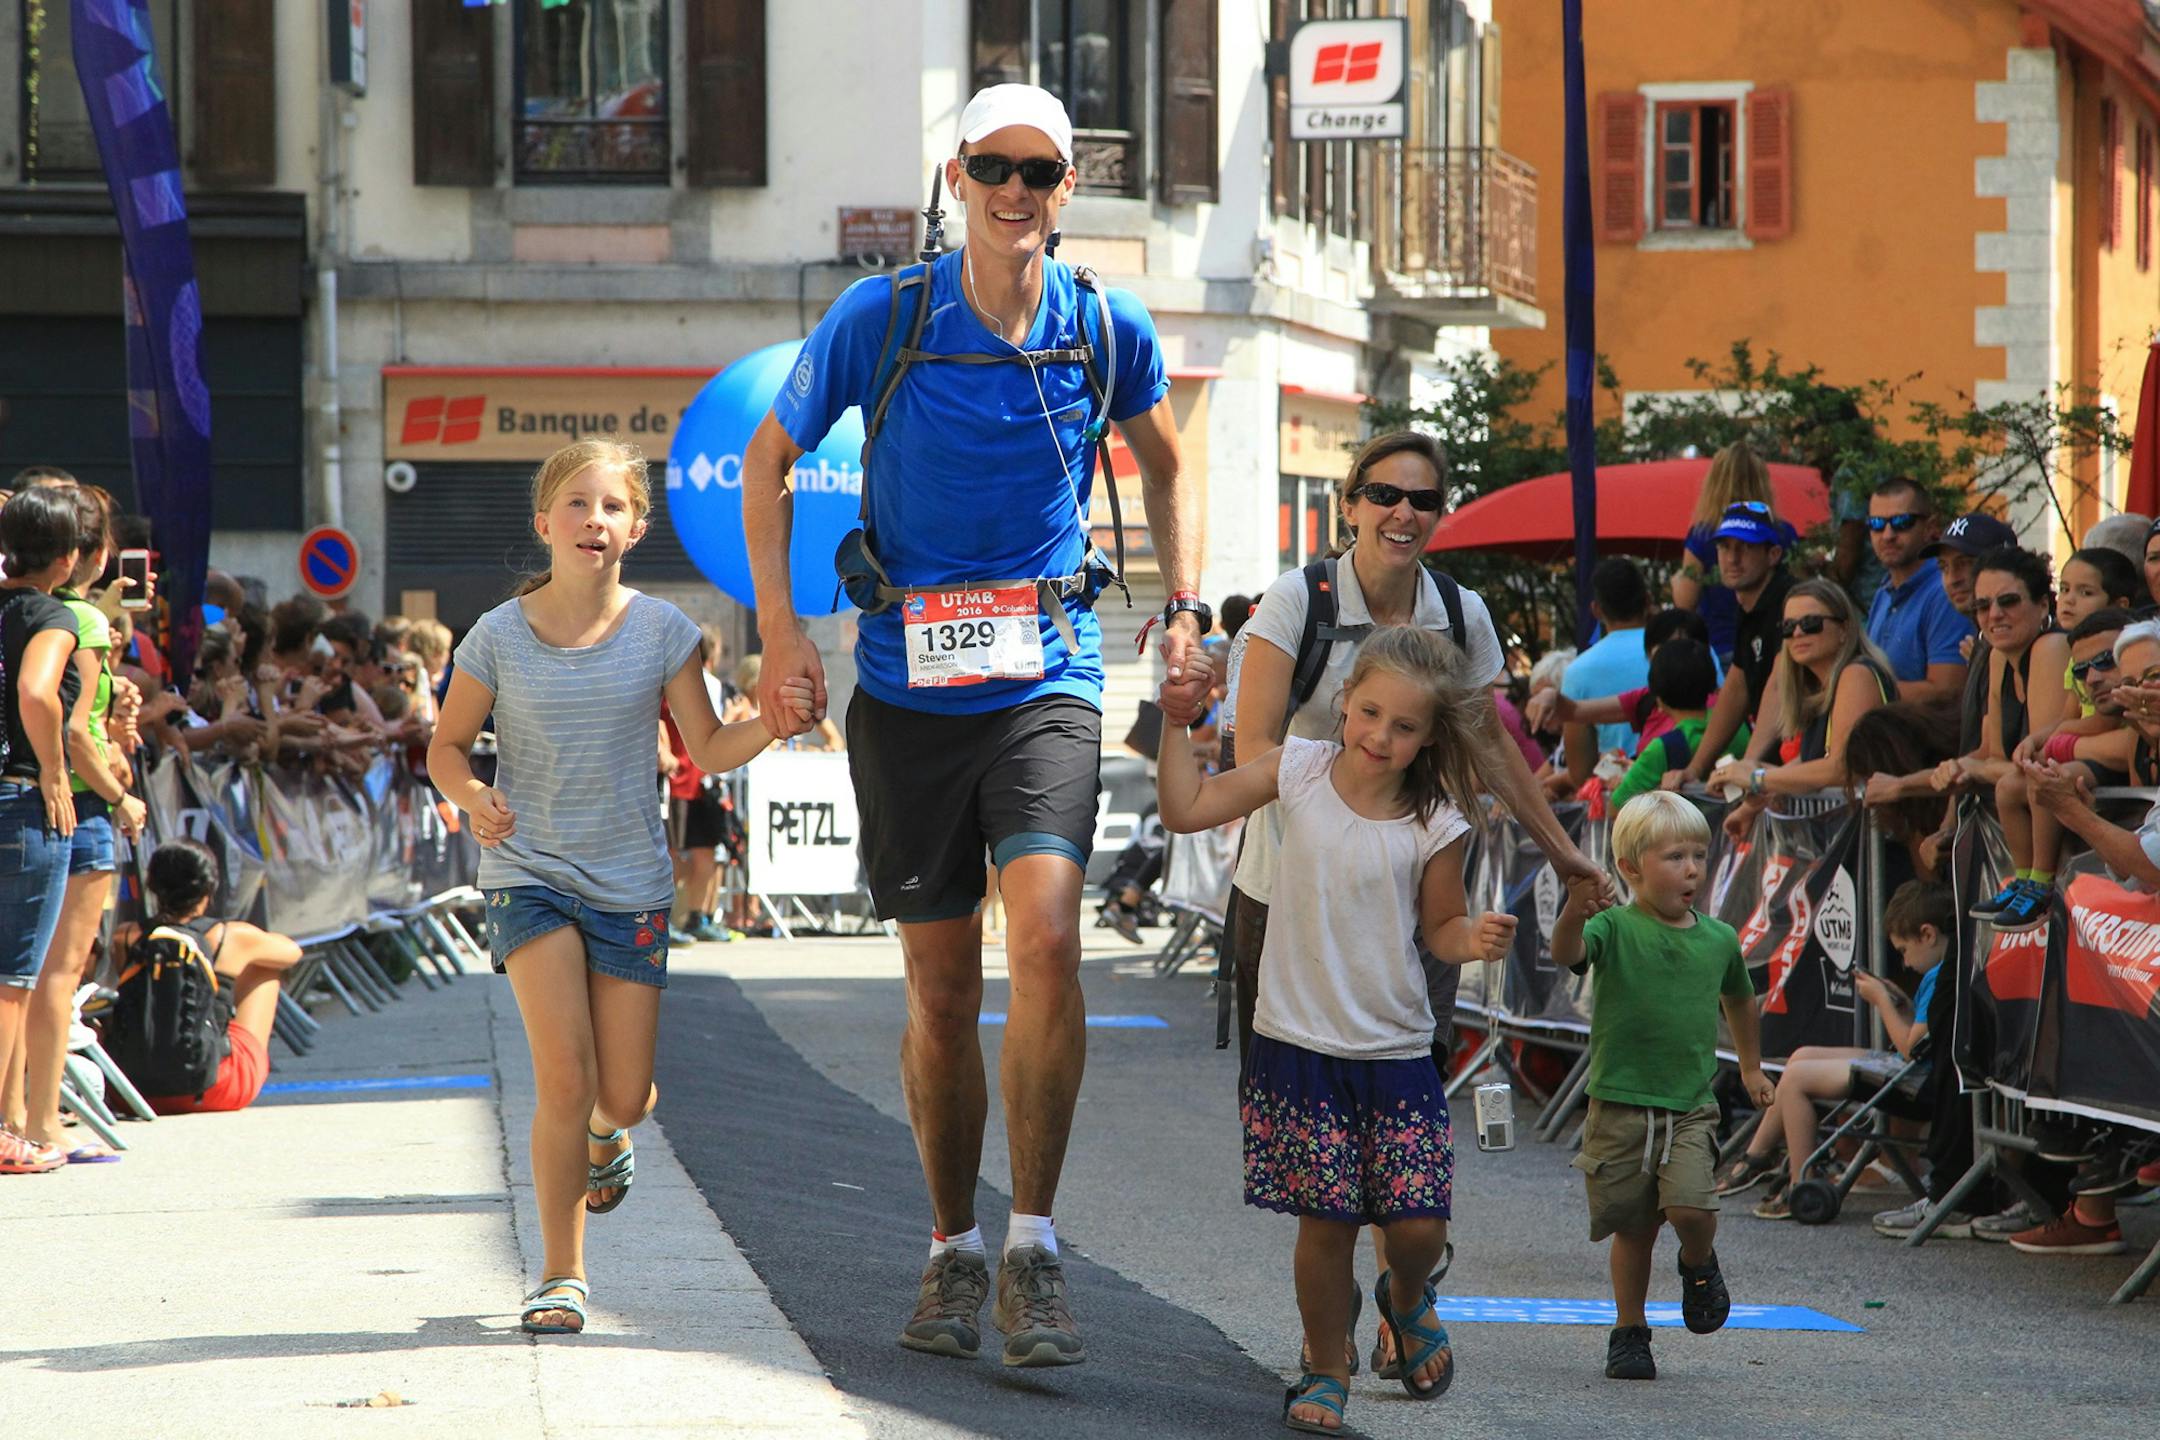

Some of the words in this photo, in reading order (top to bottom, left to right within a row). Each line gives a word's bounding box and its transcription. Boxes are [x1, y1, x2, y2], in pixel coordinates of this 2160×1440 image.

[1307, 111, 1387, 134] Change
[498, 407, 619, 440] Banque
[629, 406, 667, 432] de
[714, 453, 864, 497] Cmbia
[940, 591, 995, 608] UTMB
[957, 606, 983, 617] 2016
[921, 620, 996, 652] 1329
[918, 652, 955, 664] Steven
[769, 801, 852, 863] PETZL
[1820, 919, 1852, 940] UTMB
